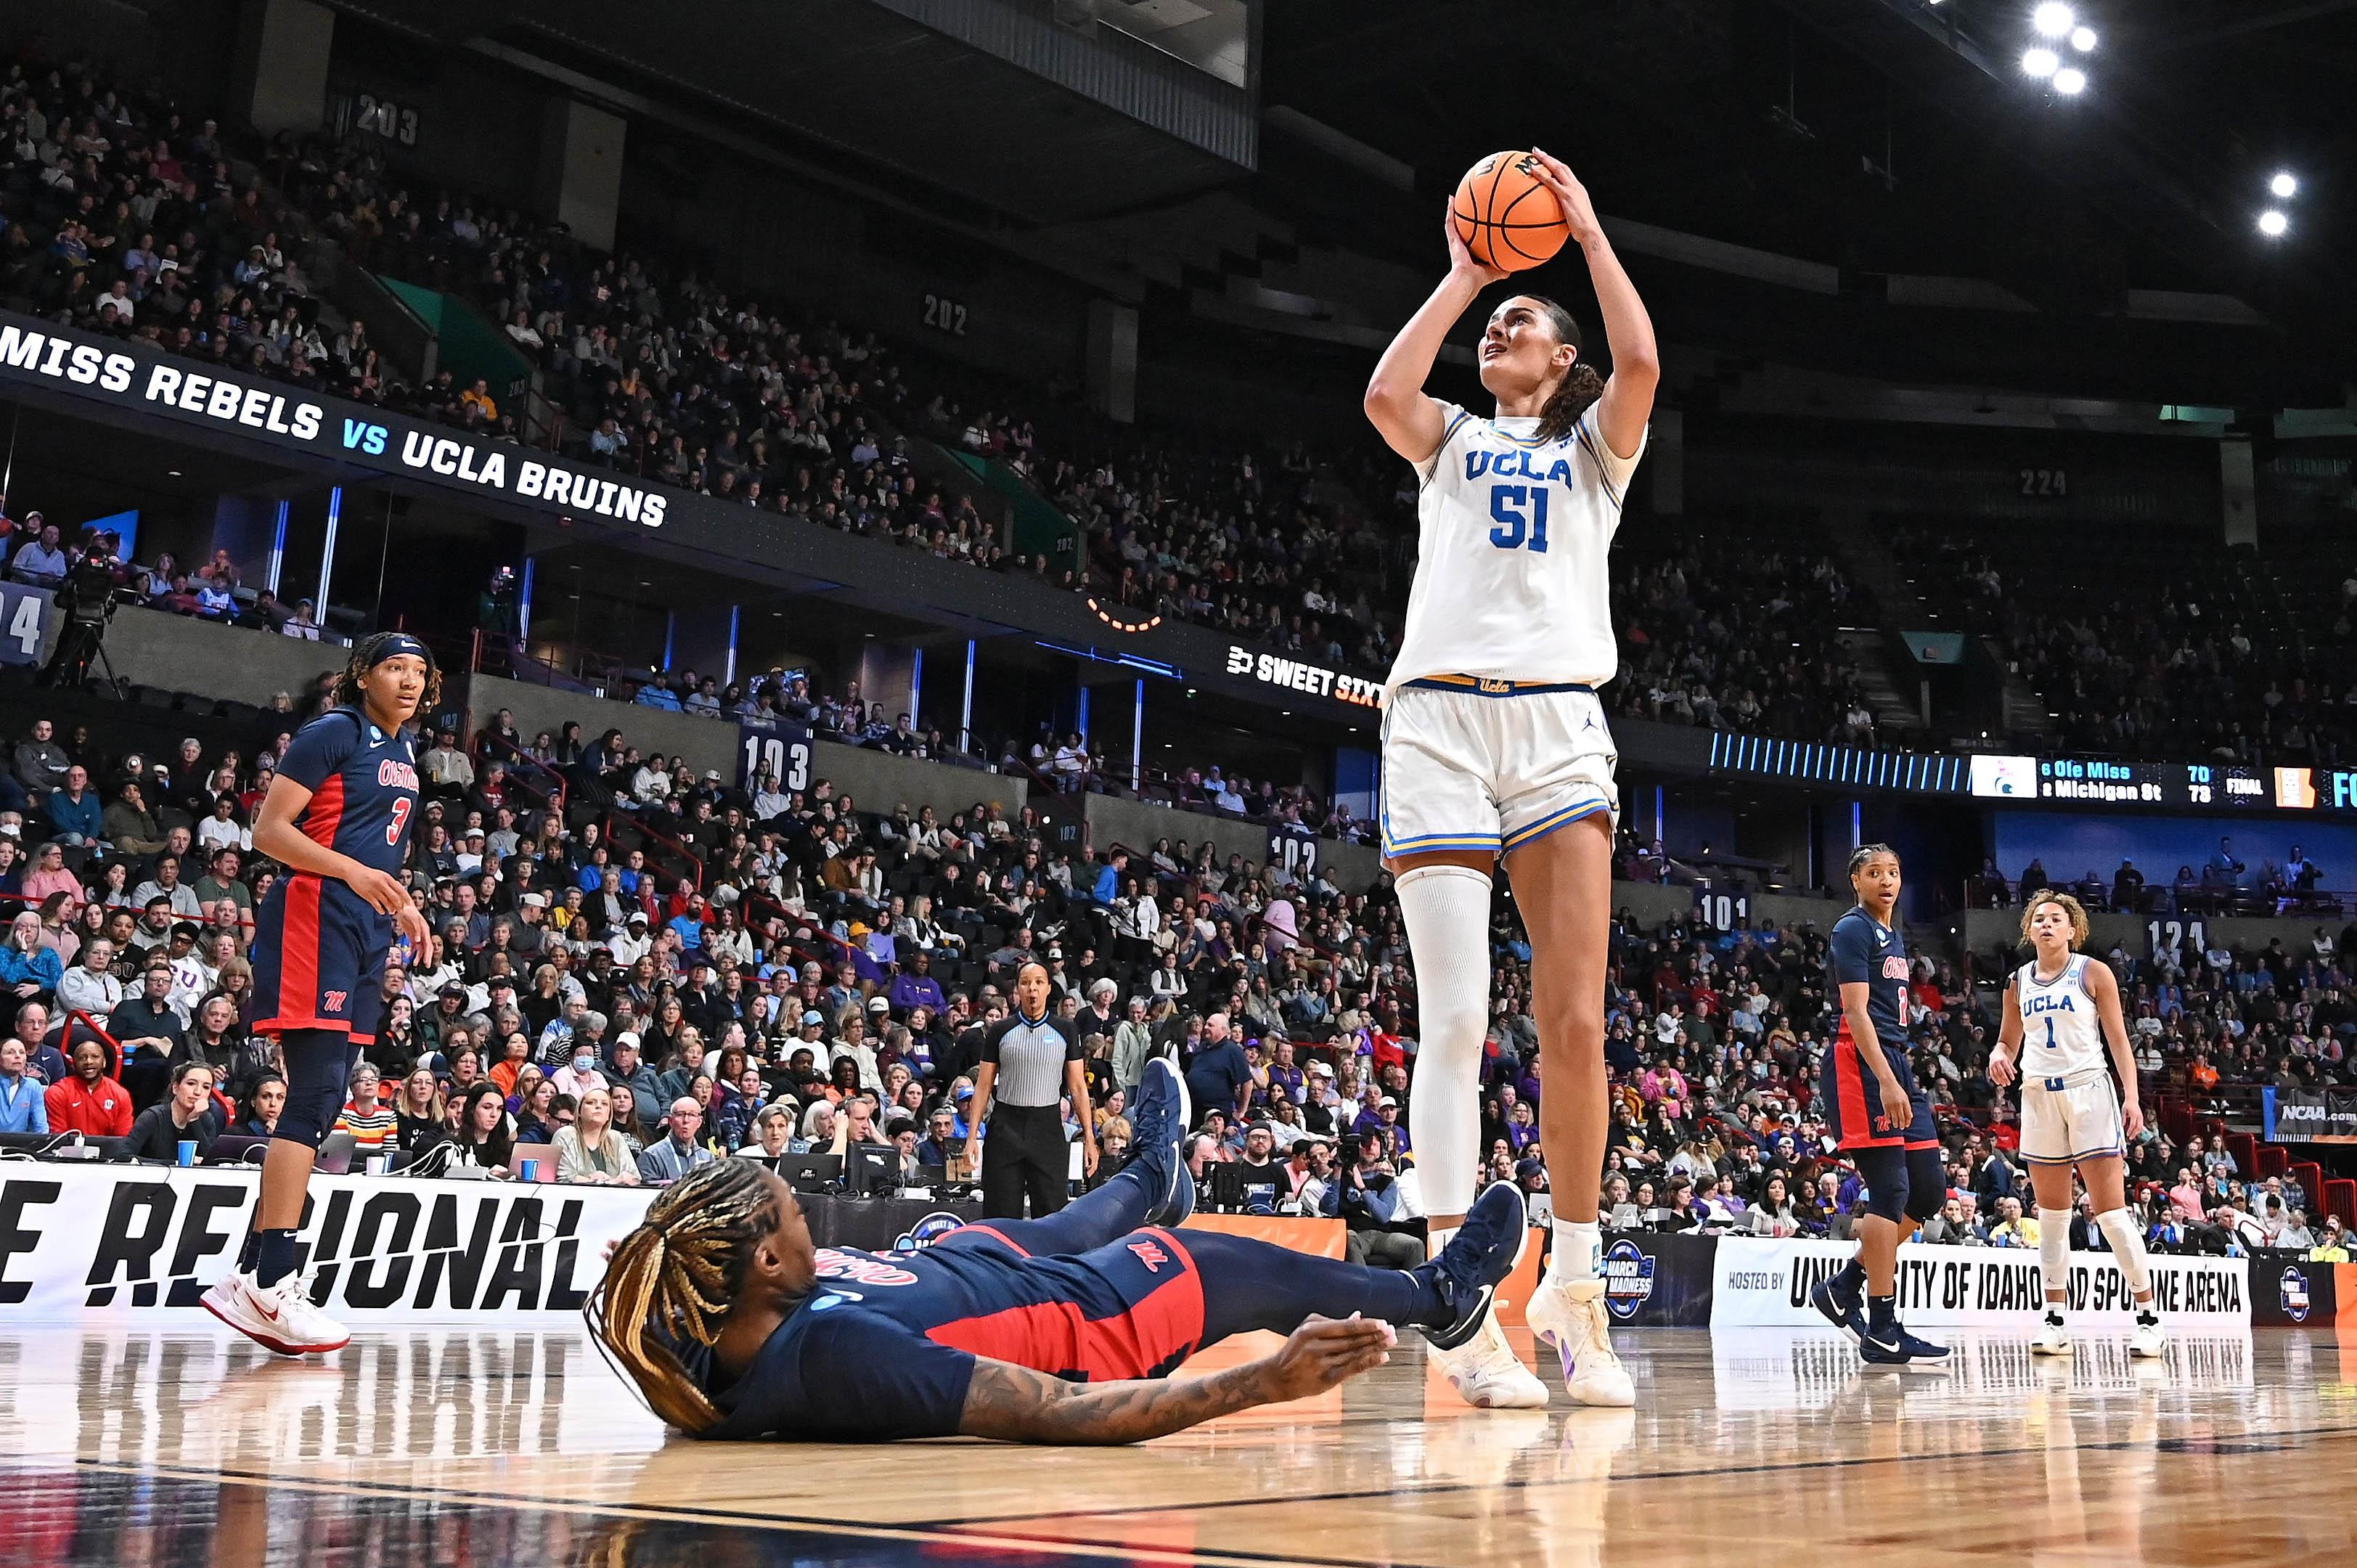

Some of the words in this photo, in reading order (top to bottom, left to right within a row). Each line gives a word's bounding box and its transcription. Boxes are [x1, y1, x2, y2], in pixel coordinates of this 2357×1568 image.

[357, 94, 418, 145] 203
[924, 293, 968, 335] 202
[0, 325, 136, 393] MISS
[145, 364, 324, 441] REBELS
[343, 418, 388, 455] VS
[401, 430, 506, 489] UCLA
[516, 461, 667, 528] BRUINS
[1466, 449, 1572, 491] UCLA
[2020, 469, 2067, 495] 224
[1490, 485, 1548, 553] 51
[0, 591, 42, 654] 4
[1257, 653, 1335, 697] SWEET
[1479, 677, 1510, 693] Ucla
[746, 735, 809, 791] 103
[2041, 763, 2051, 776] 6
[2054, 760, 2083, 777] Ole
[2087, 762, 2131, 780] Miss
[2187, 765, 2210, 783] 70
[2055, 779, 2139, 801] Michigan
[2141, 783, 2162, 801] St
[2226, 777, 2263, 795] FINAL
[386, 797, 411, 846] 3
[1701, 894, 1746, 931] 101
[2024, 995, 2075, 1018] UCLA
[2044, 1016, 2056, 1048] 1
[2282, 1105, 2357, 1122] NCAA.com
[85, 1181, 589, 1310] REIONAL
[1606, 1260, 1638, 1277] MARCH
[1609, 1278, 1651, 1293] MADNESS
[1728, 1272, 1768, 1290] HOSTED
[1771, 1272, 1784, 1290] BY
[1943, 1262, 1971, 1309] OF
[1977, 1263, 2043, 1310] IDAHO
[2065, 1267, 2088, 1310] ND
[2093, 1267, 2178, 1312] SPONE
[2184, 1271, 2241, 1312] ARENA
